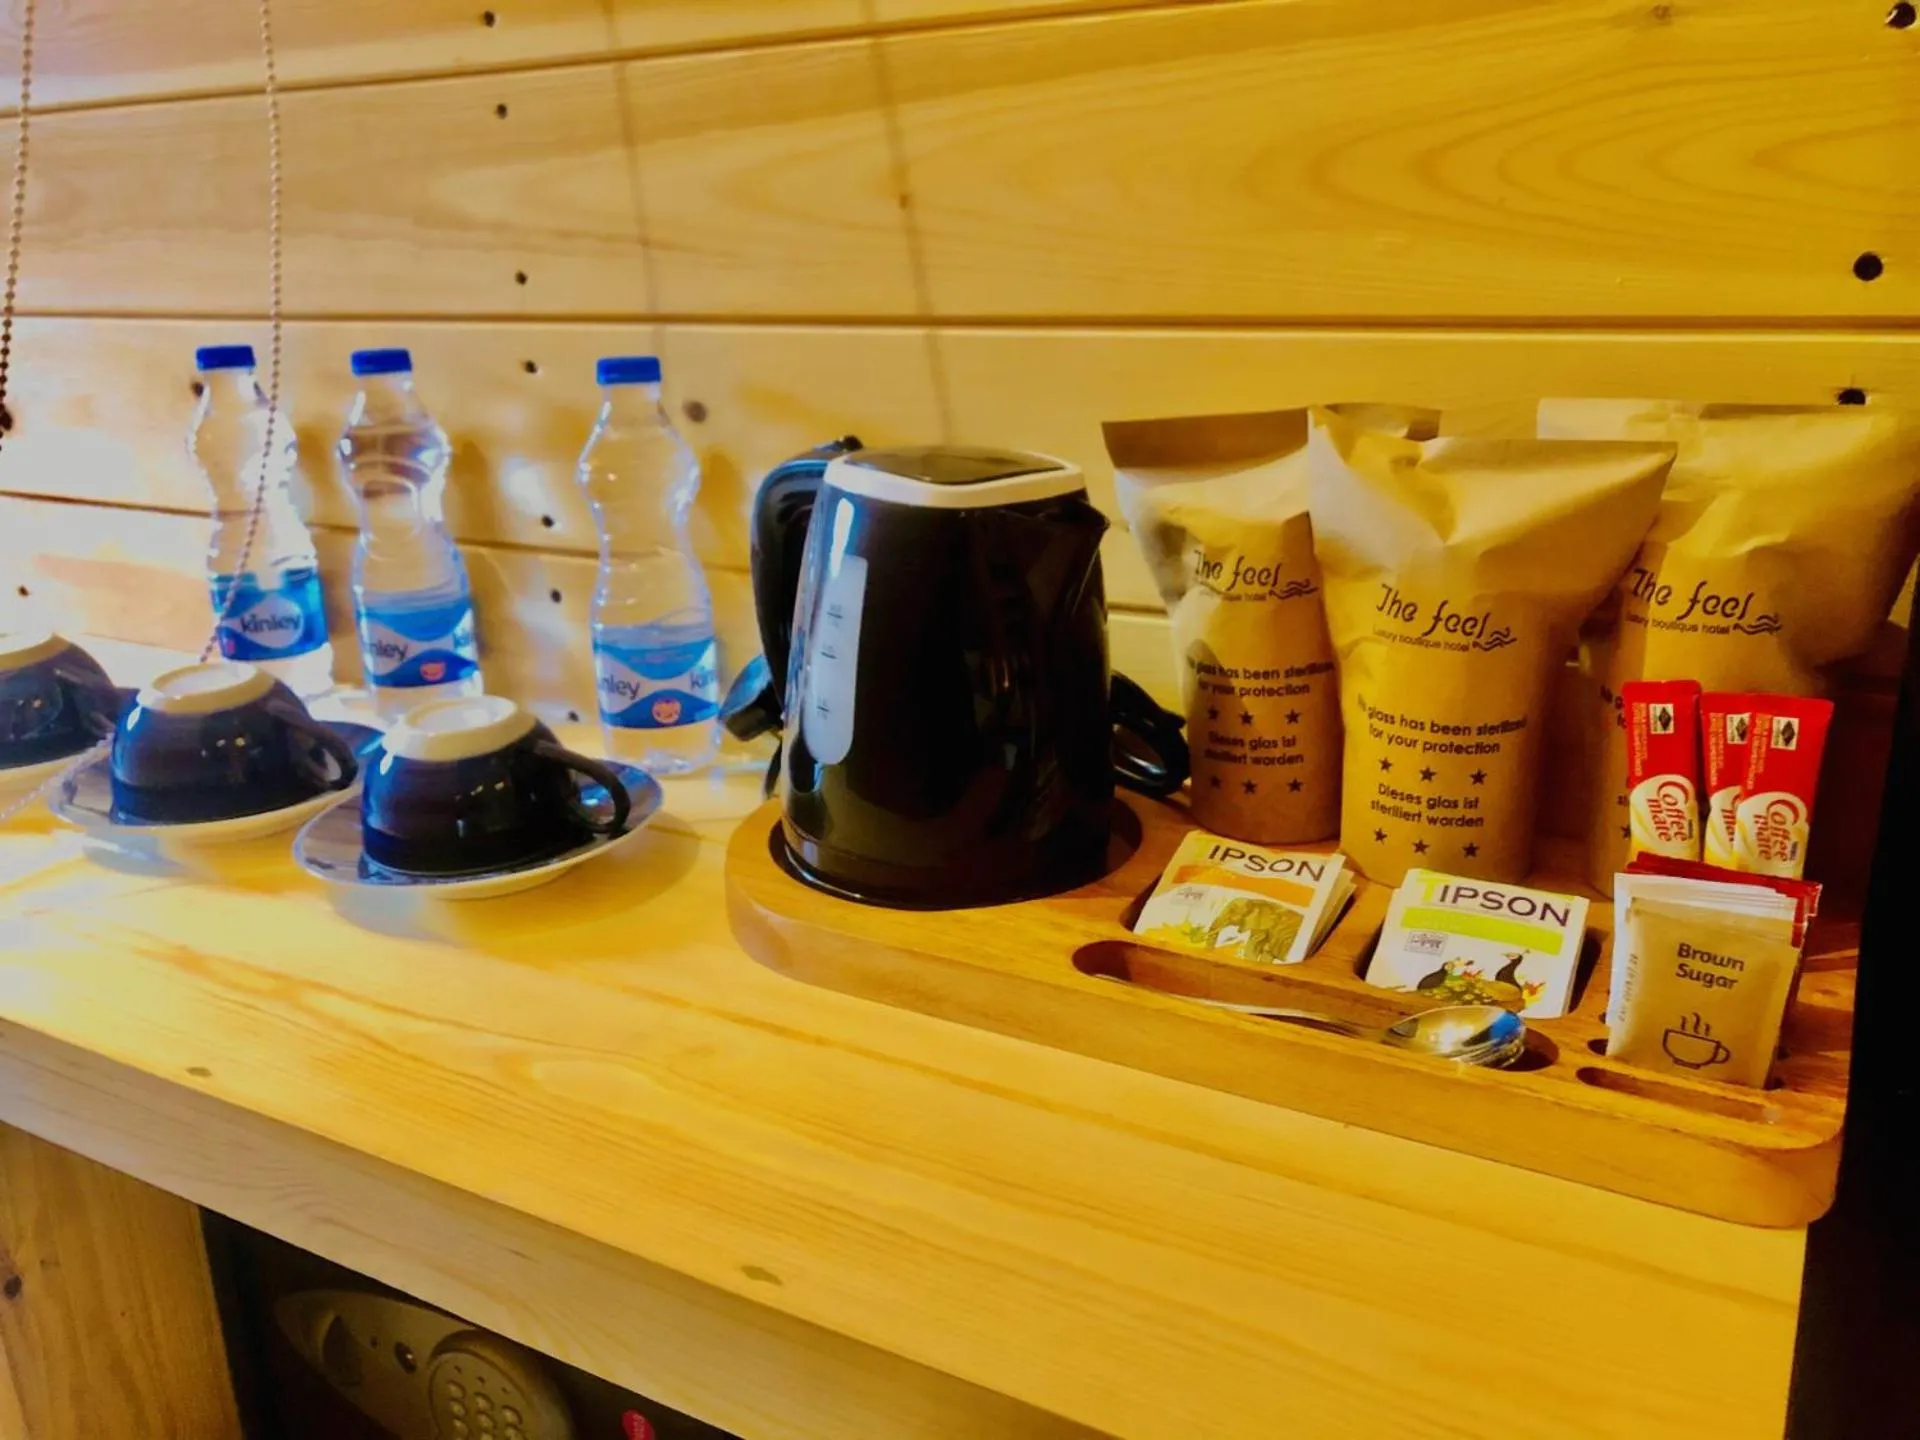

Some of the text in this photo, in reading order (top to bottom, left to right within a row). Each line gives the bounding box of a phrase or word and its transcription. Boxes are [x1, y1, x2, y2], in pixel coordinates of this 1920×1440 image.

[1193, 549, 1283, 592] The feel
[1631, 567, 1755, 621] The feel
[1376, 583, 1491, 639] The feel
[1238, 683, 1311, 698] protection
[1242, 668, 1281, 681] been
[1369, 723, 1502, 756] for your protection
[1400, 713, 1426, 731] has
[1430, 719, 1472, 737] been
[1248, 736, 1279, 751] glas
[1377, 782, 1481, 811] Dieses glas ist
[1658, 780, 1690, 842] Coffee
[1646, 798, 1673, 843] mate
[1766, 799, 1800, 863] Coffee
[1753, 814, 1774, 861] mate
[1676, 942, 1745, 972] Brown
[1675, 963, 1739, 990] Sugar
